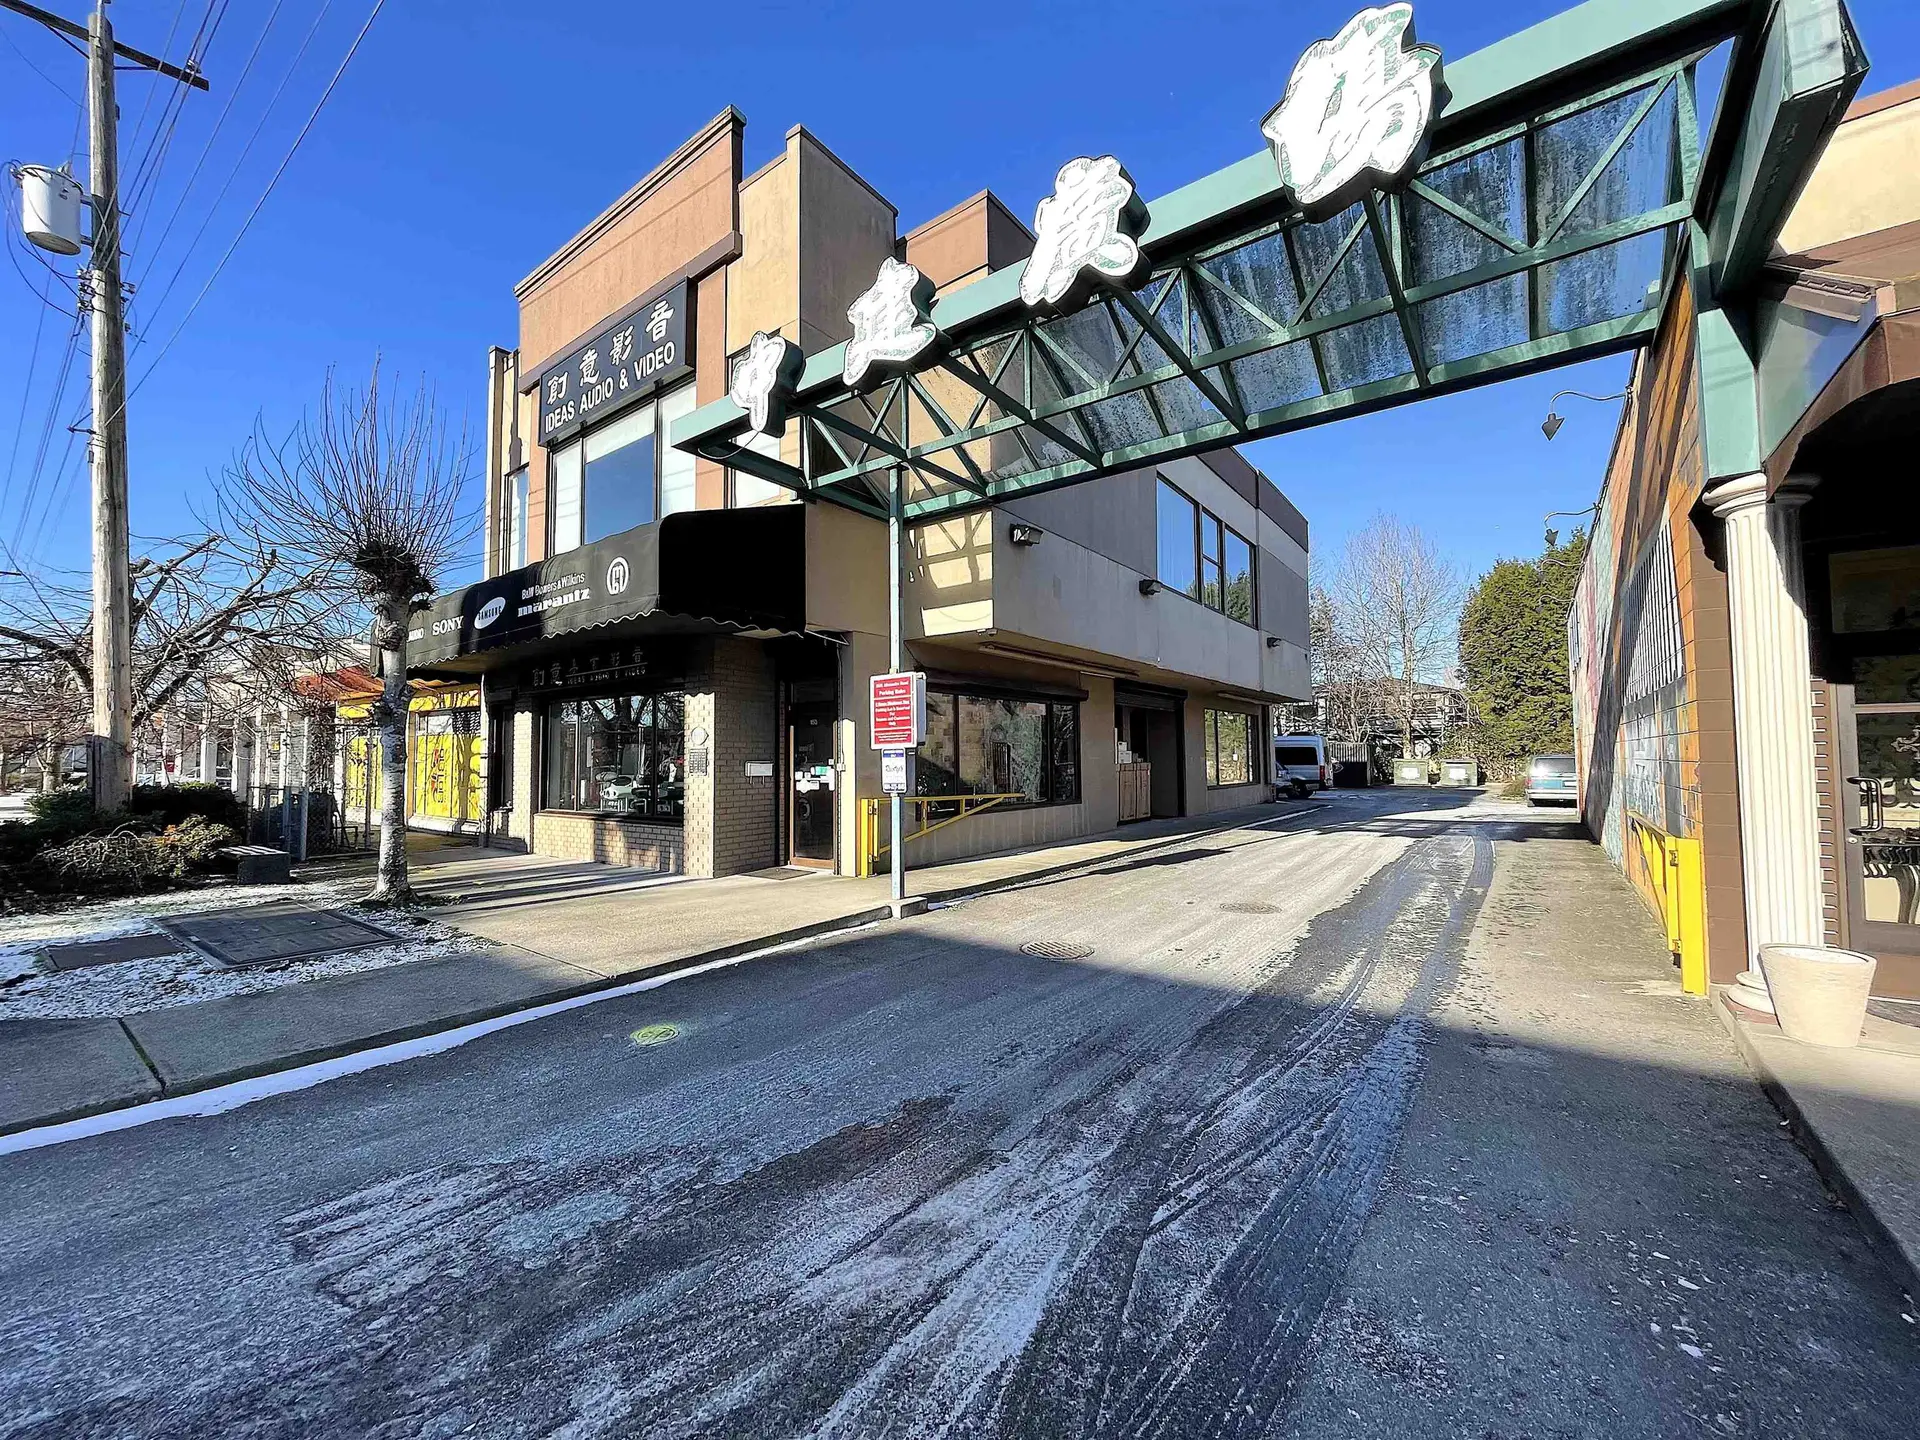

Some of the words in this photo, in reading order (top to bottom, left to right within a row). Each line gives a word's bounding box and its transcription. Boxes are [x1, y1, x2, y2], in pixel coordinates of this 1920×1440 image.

[545, 401, 575, 434] IDEAS
[579, 377, 614, 415] AUDIO
[619, 368, 629, 390] &
[634, 341, 675, 381] VIDEO
[517, 587, 590, 617] marantz
[432, 615, 464, 636] SONY
